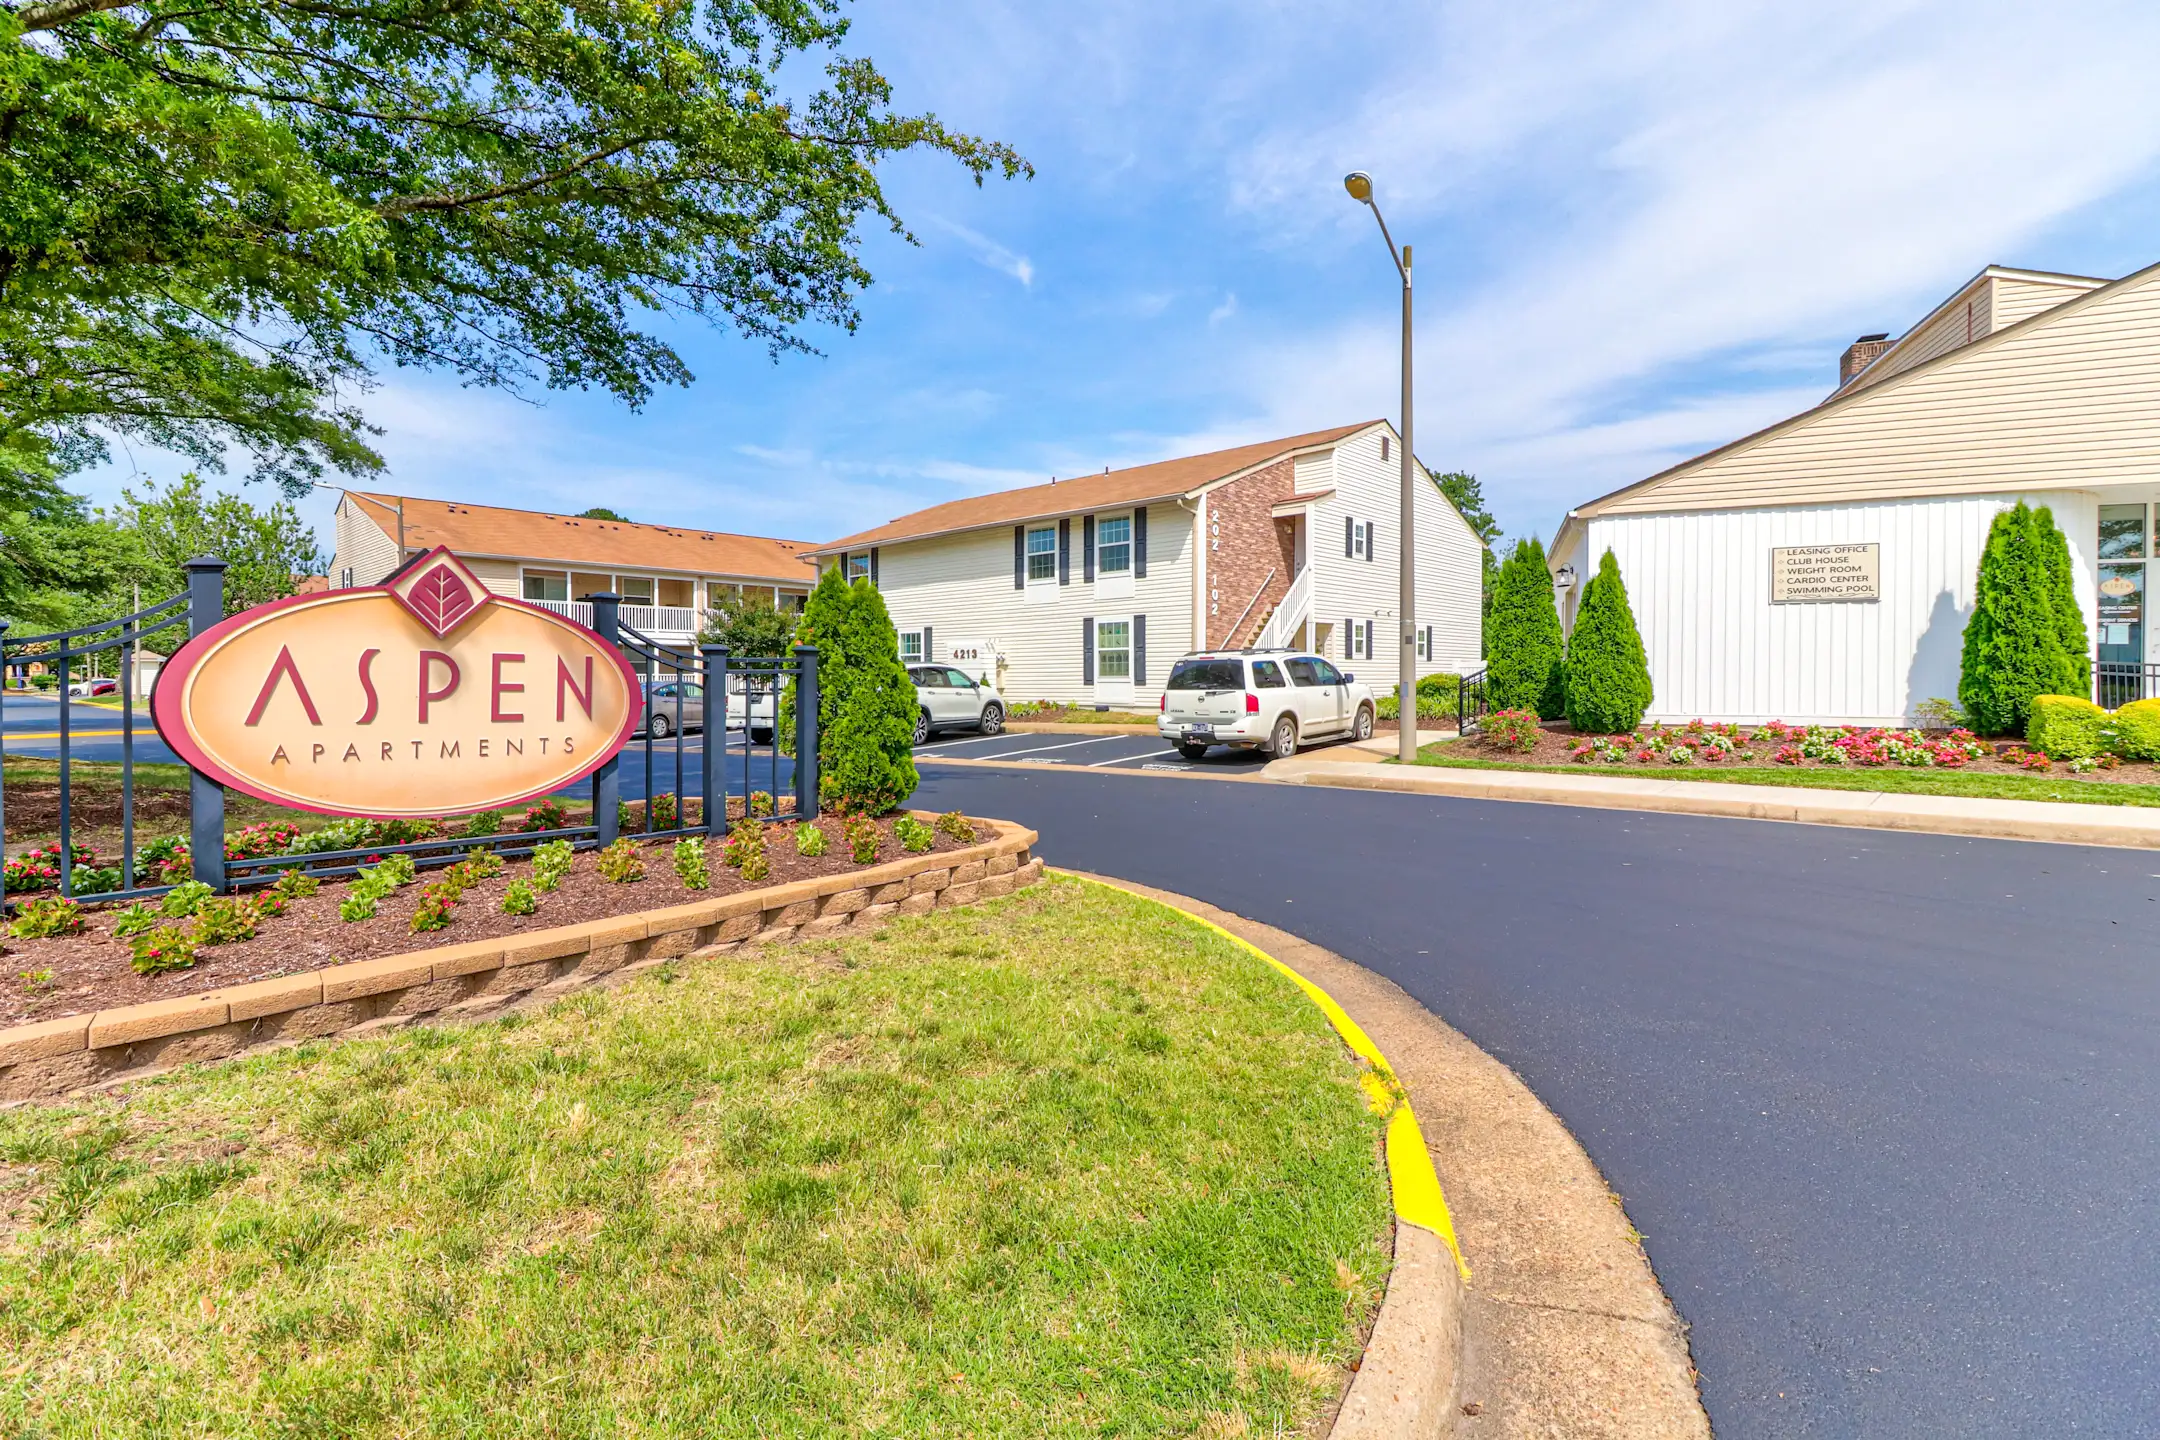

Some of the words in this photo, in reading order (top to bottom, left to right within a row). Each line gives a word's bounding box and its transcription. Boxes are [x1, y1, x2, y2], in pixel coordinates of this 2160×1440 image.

[1211, 509, 1219, 552] 202
[1787, 547, 1831, 556] LEASING
[1834, 545, 1868, 554] OFFICE
[1786, 557, 1812, 566] CLUB
[1815, 556, 1850, 564] HOUSE
[1787, 566, 1827, 575] WEIGHT
[1829, 565, 1862, 573] ROOM
[1786, 576, 1826, 585] CARDIO
[1829, 575, 1869, 583] CENTER
[1211, 573, 1219, 616] 102
[1786, 585, 1843, 595] SWIMMING
[1846, 584, 1875, 593] POOL
[952, 649, 978, 660] 4213
[243, 643, 594, 727] ASPEN
[270, 735, 576, 765] APARTMENTS
